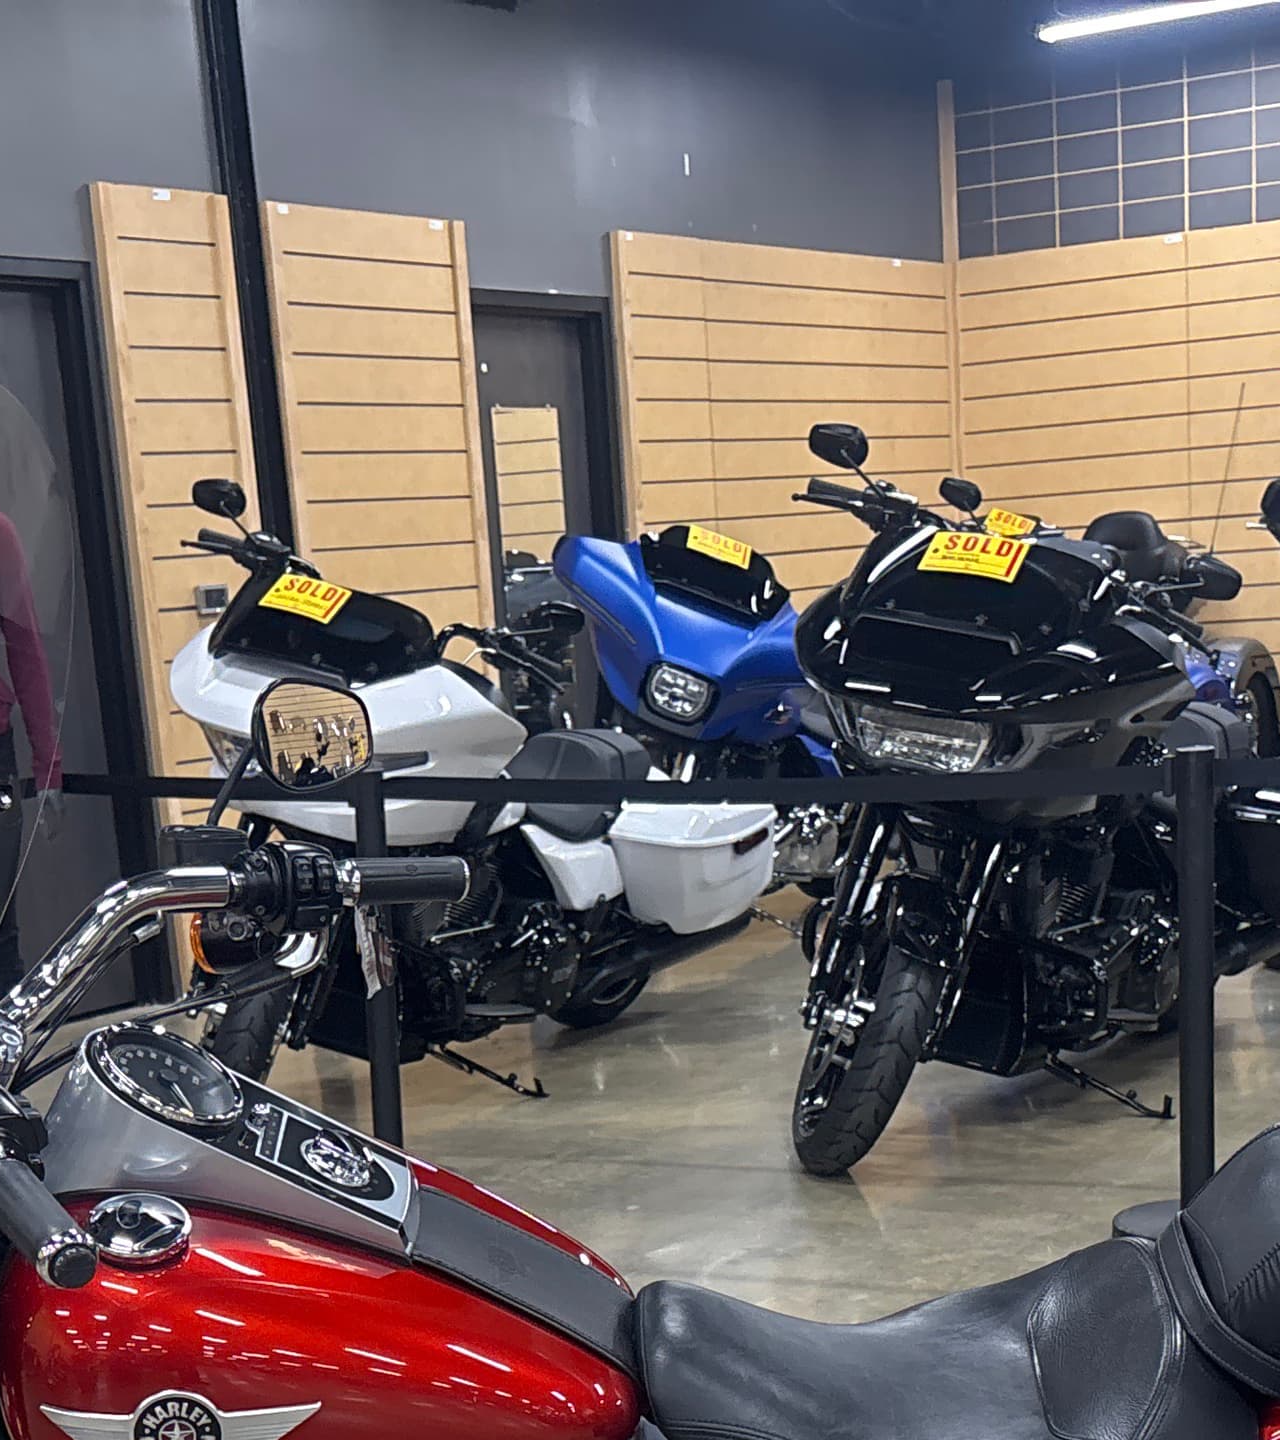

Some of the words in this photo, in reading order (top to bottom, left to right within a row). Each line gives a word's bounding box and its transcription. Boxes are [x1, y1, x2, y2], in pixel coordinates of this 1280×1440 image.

[994, 511, 1028, 529] SOLD
[701, 530, 742, 553] SOLD
[943, 534, 1014, 558] SOLD
[283, 577, 339, 602] SOLD
[141, 1401, 210, 1428] HARLEY
